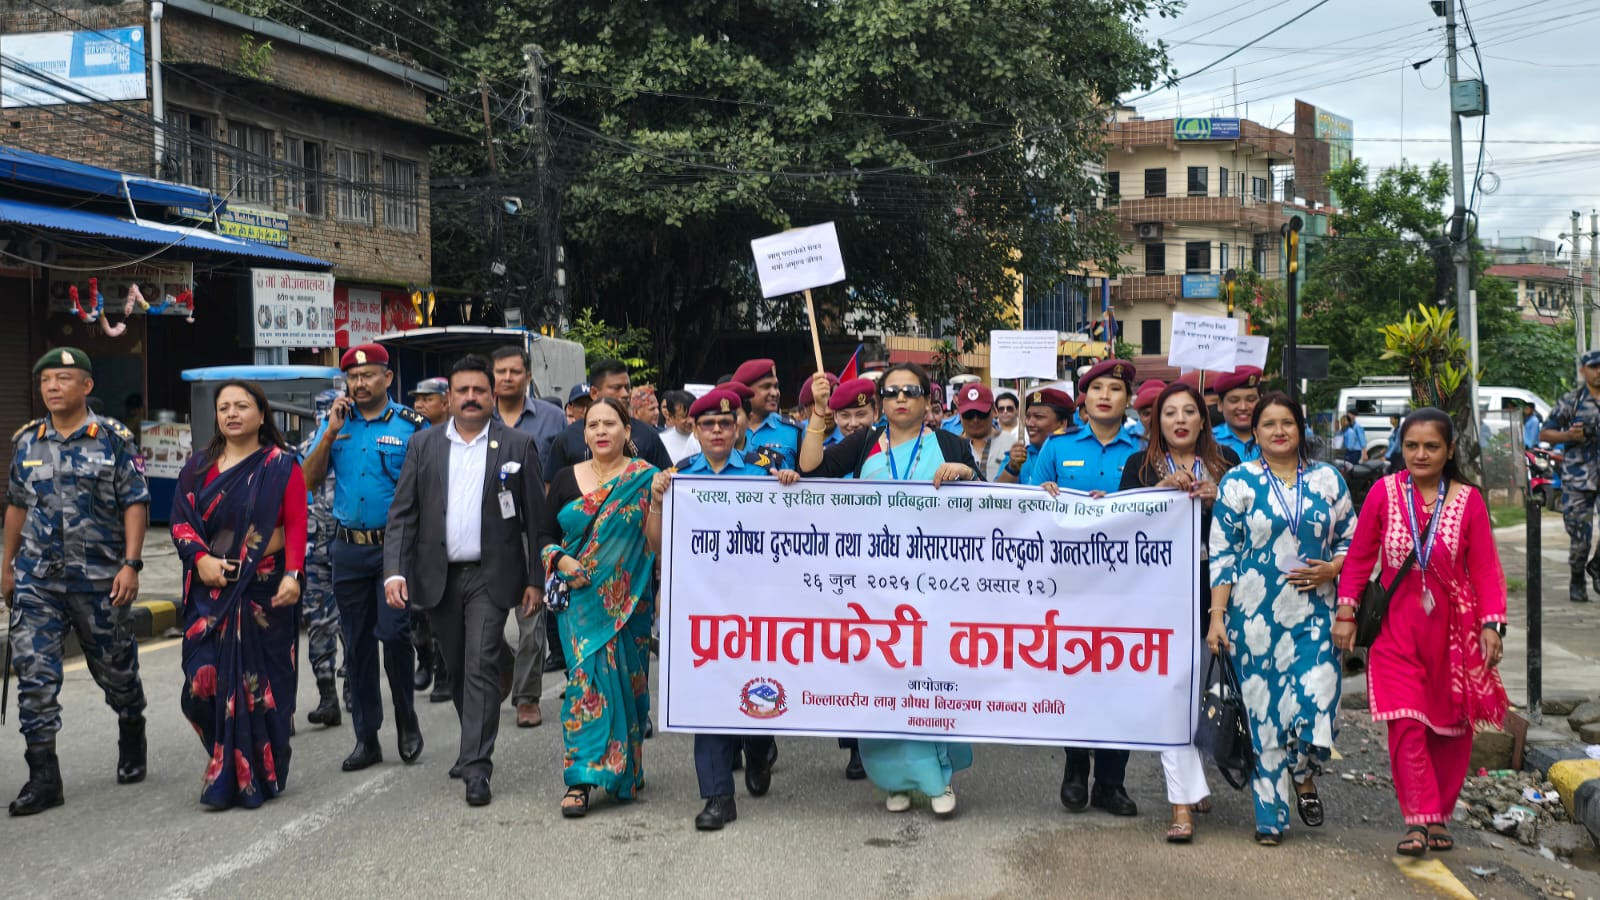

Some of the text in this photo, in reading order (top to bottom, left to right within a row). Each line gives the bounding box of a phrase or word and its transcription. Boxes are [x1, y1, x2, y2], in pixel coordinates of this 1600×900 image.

[736, 490, 763, 504] सभ्य
[769, 491, 777, 505] र
[783, 489, 825, 508] सुरक्षित
[831, 491, 881, 506] समाजको
[948, 499, 973, 513] लागु
[979, 494, 1012, 510] औषध
[691, 529, 720, 562] लागु
[726, 521, 765, 555] औषध
[835, 532, 861, 557] तथा
[868, 524, 900, 558] अवैध
[906, 526, 986, 562] ओसारपसार
[1135, 530, 1173, 567] दिवस
[803, 572, 823, 592] २६
[829, 573, 857, 595] जुन
[867, 574, 910, 591] २०२५
[977, 578, 1020, 594] असार
[688, 602, 1175, 676] प्रभातफेरी कार्यक्रम
[802, 690, 1065, 715] जिल्लास्तरीय लागु औषध नियन्त्रण समन्वय समिति
[908, 717, 955, 731] मकवानपुर
